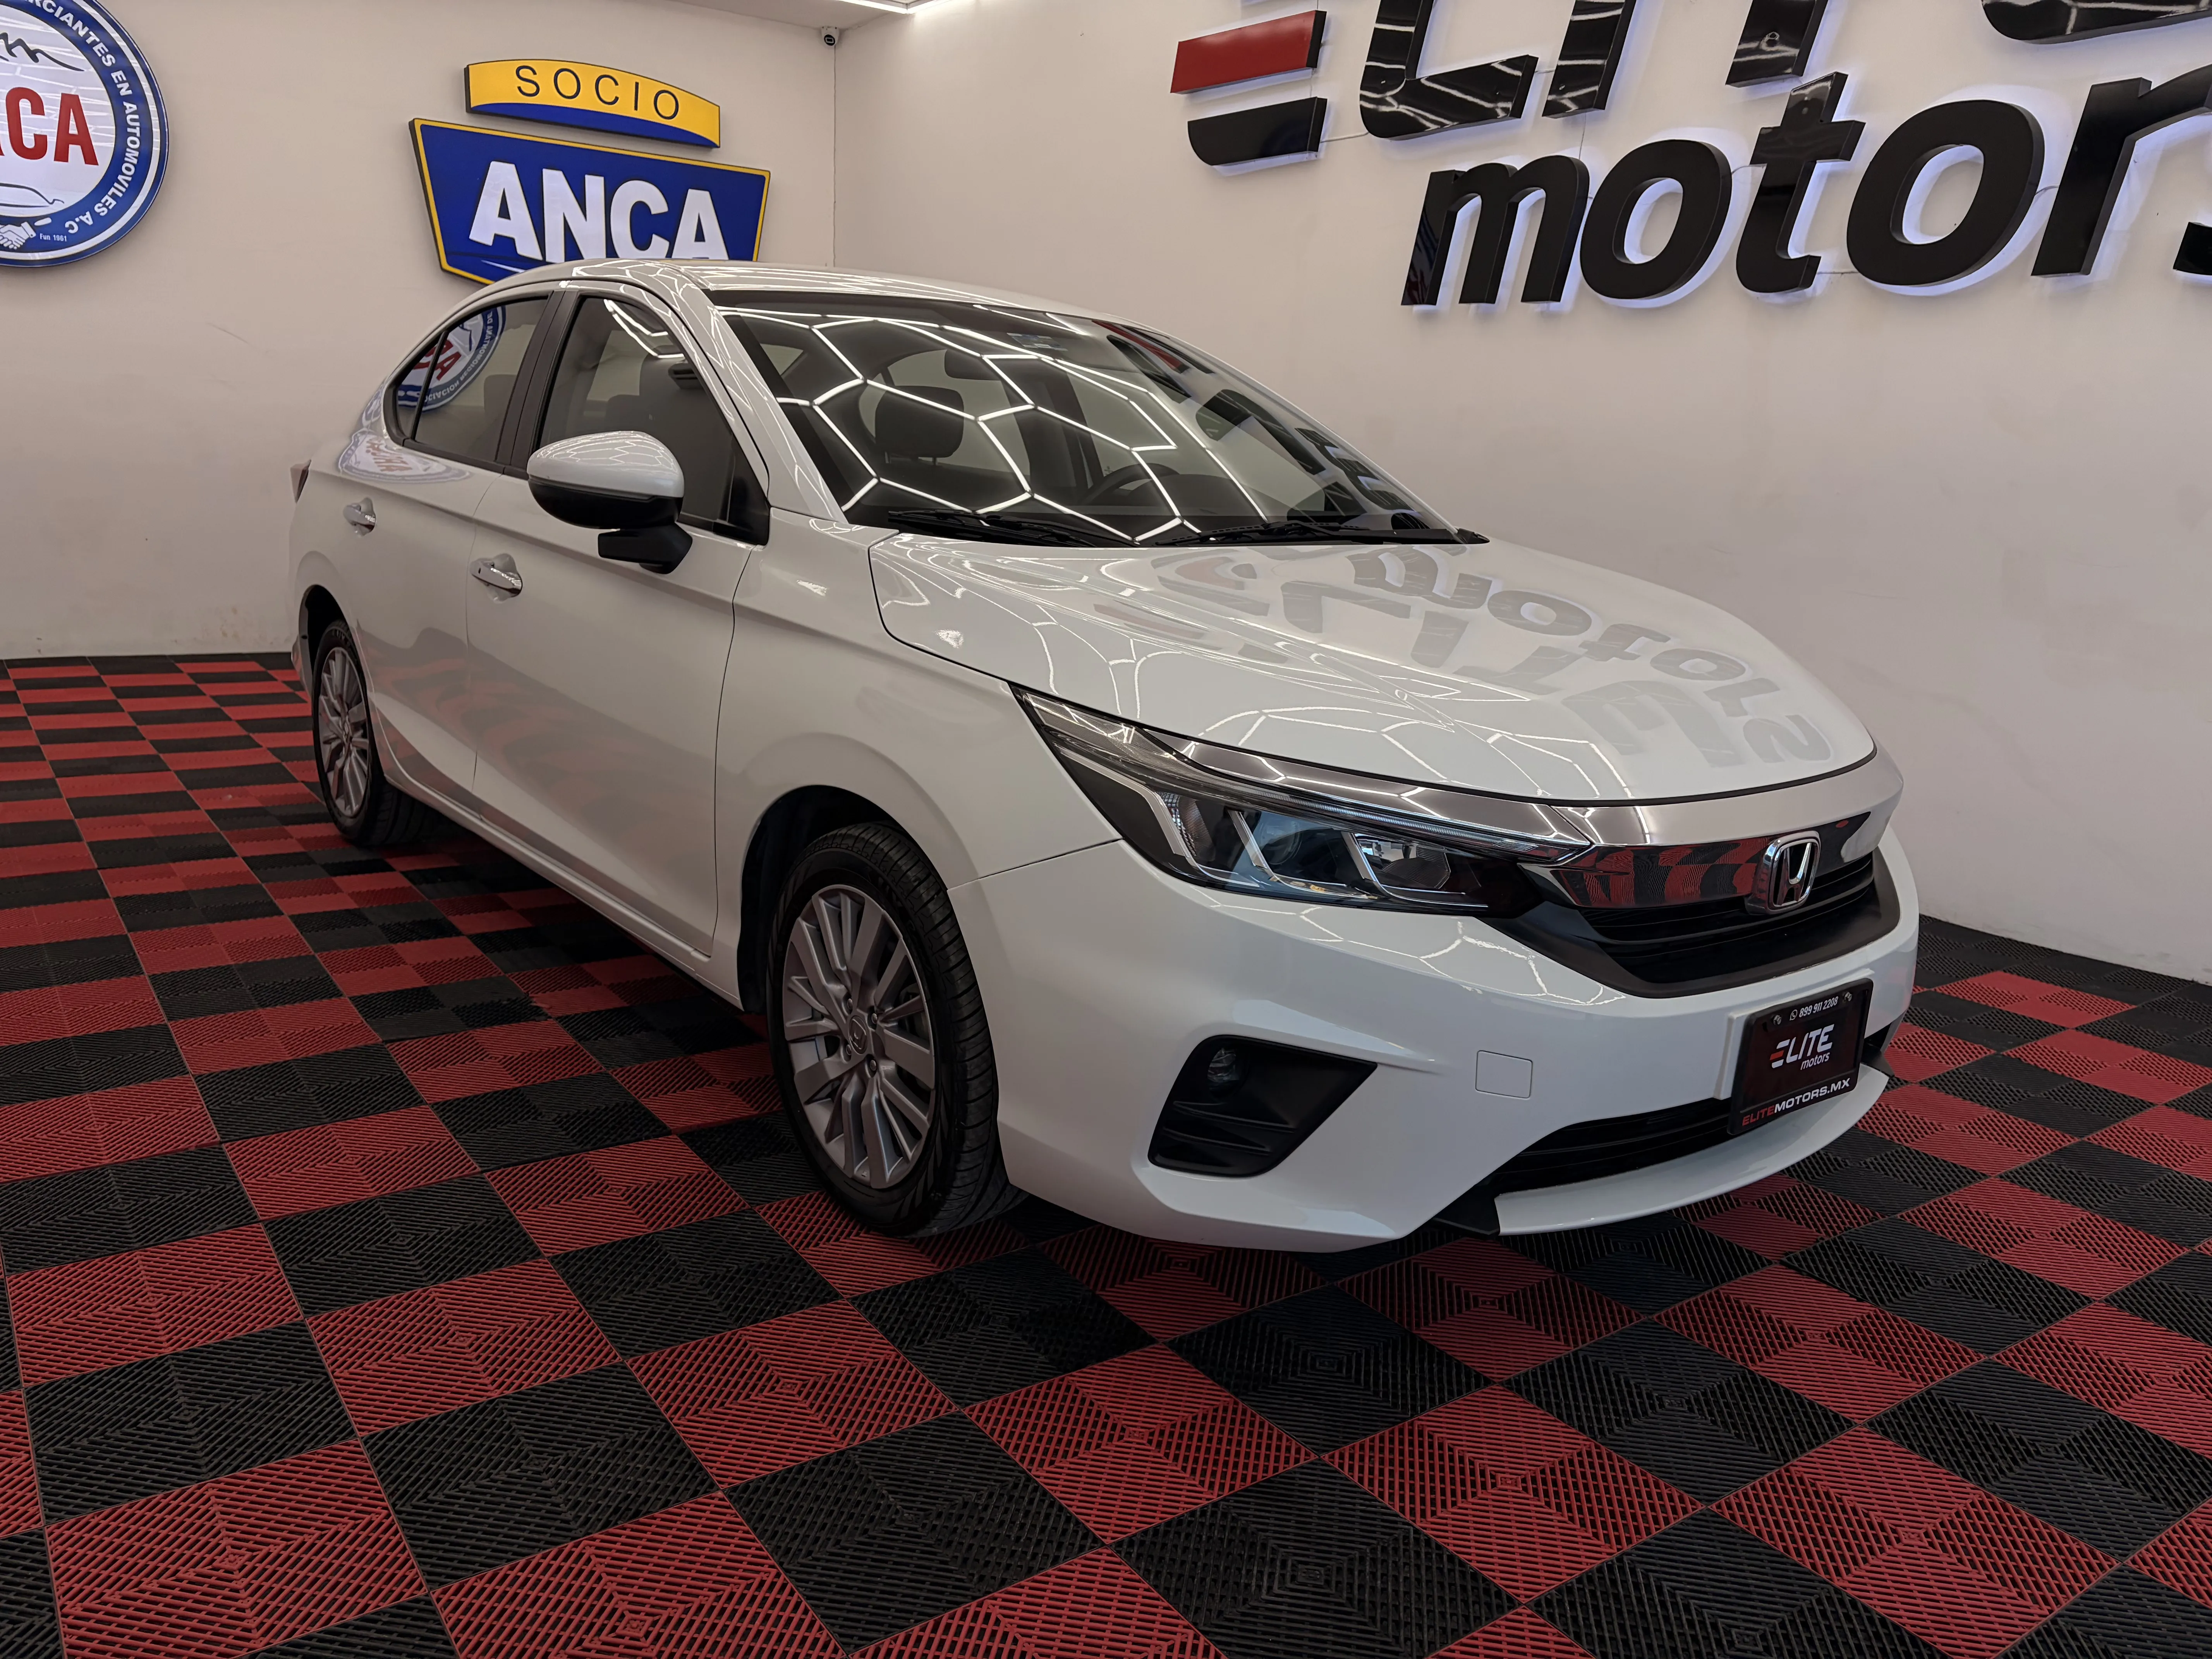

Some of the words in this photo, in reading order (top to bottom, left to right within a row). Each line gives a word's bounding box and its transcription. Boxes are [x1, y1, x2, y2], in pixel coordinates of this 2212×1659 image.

[111, 70, 133, 96] EN
[515, 65, 679, 120] SOCIO
[0, 87, 99, 166] CA
[94, 101, 141, 216] AUTOMOVILES
[1401, 64, 2212, 305] motor
[469, 161, 730, 263] ANCA
[1799, 1005, 1812, 1018] 899
[1812, 1001, 1823, 1013] 911
[1822, 996, 1839, 1010] 2208
[1769, 1024, 1835, 1069] ELITE
[1800, 1052, 1830, 1070] motors
[1742, 1078, 1850, 1126] ELITEMOTORS.MX
